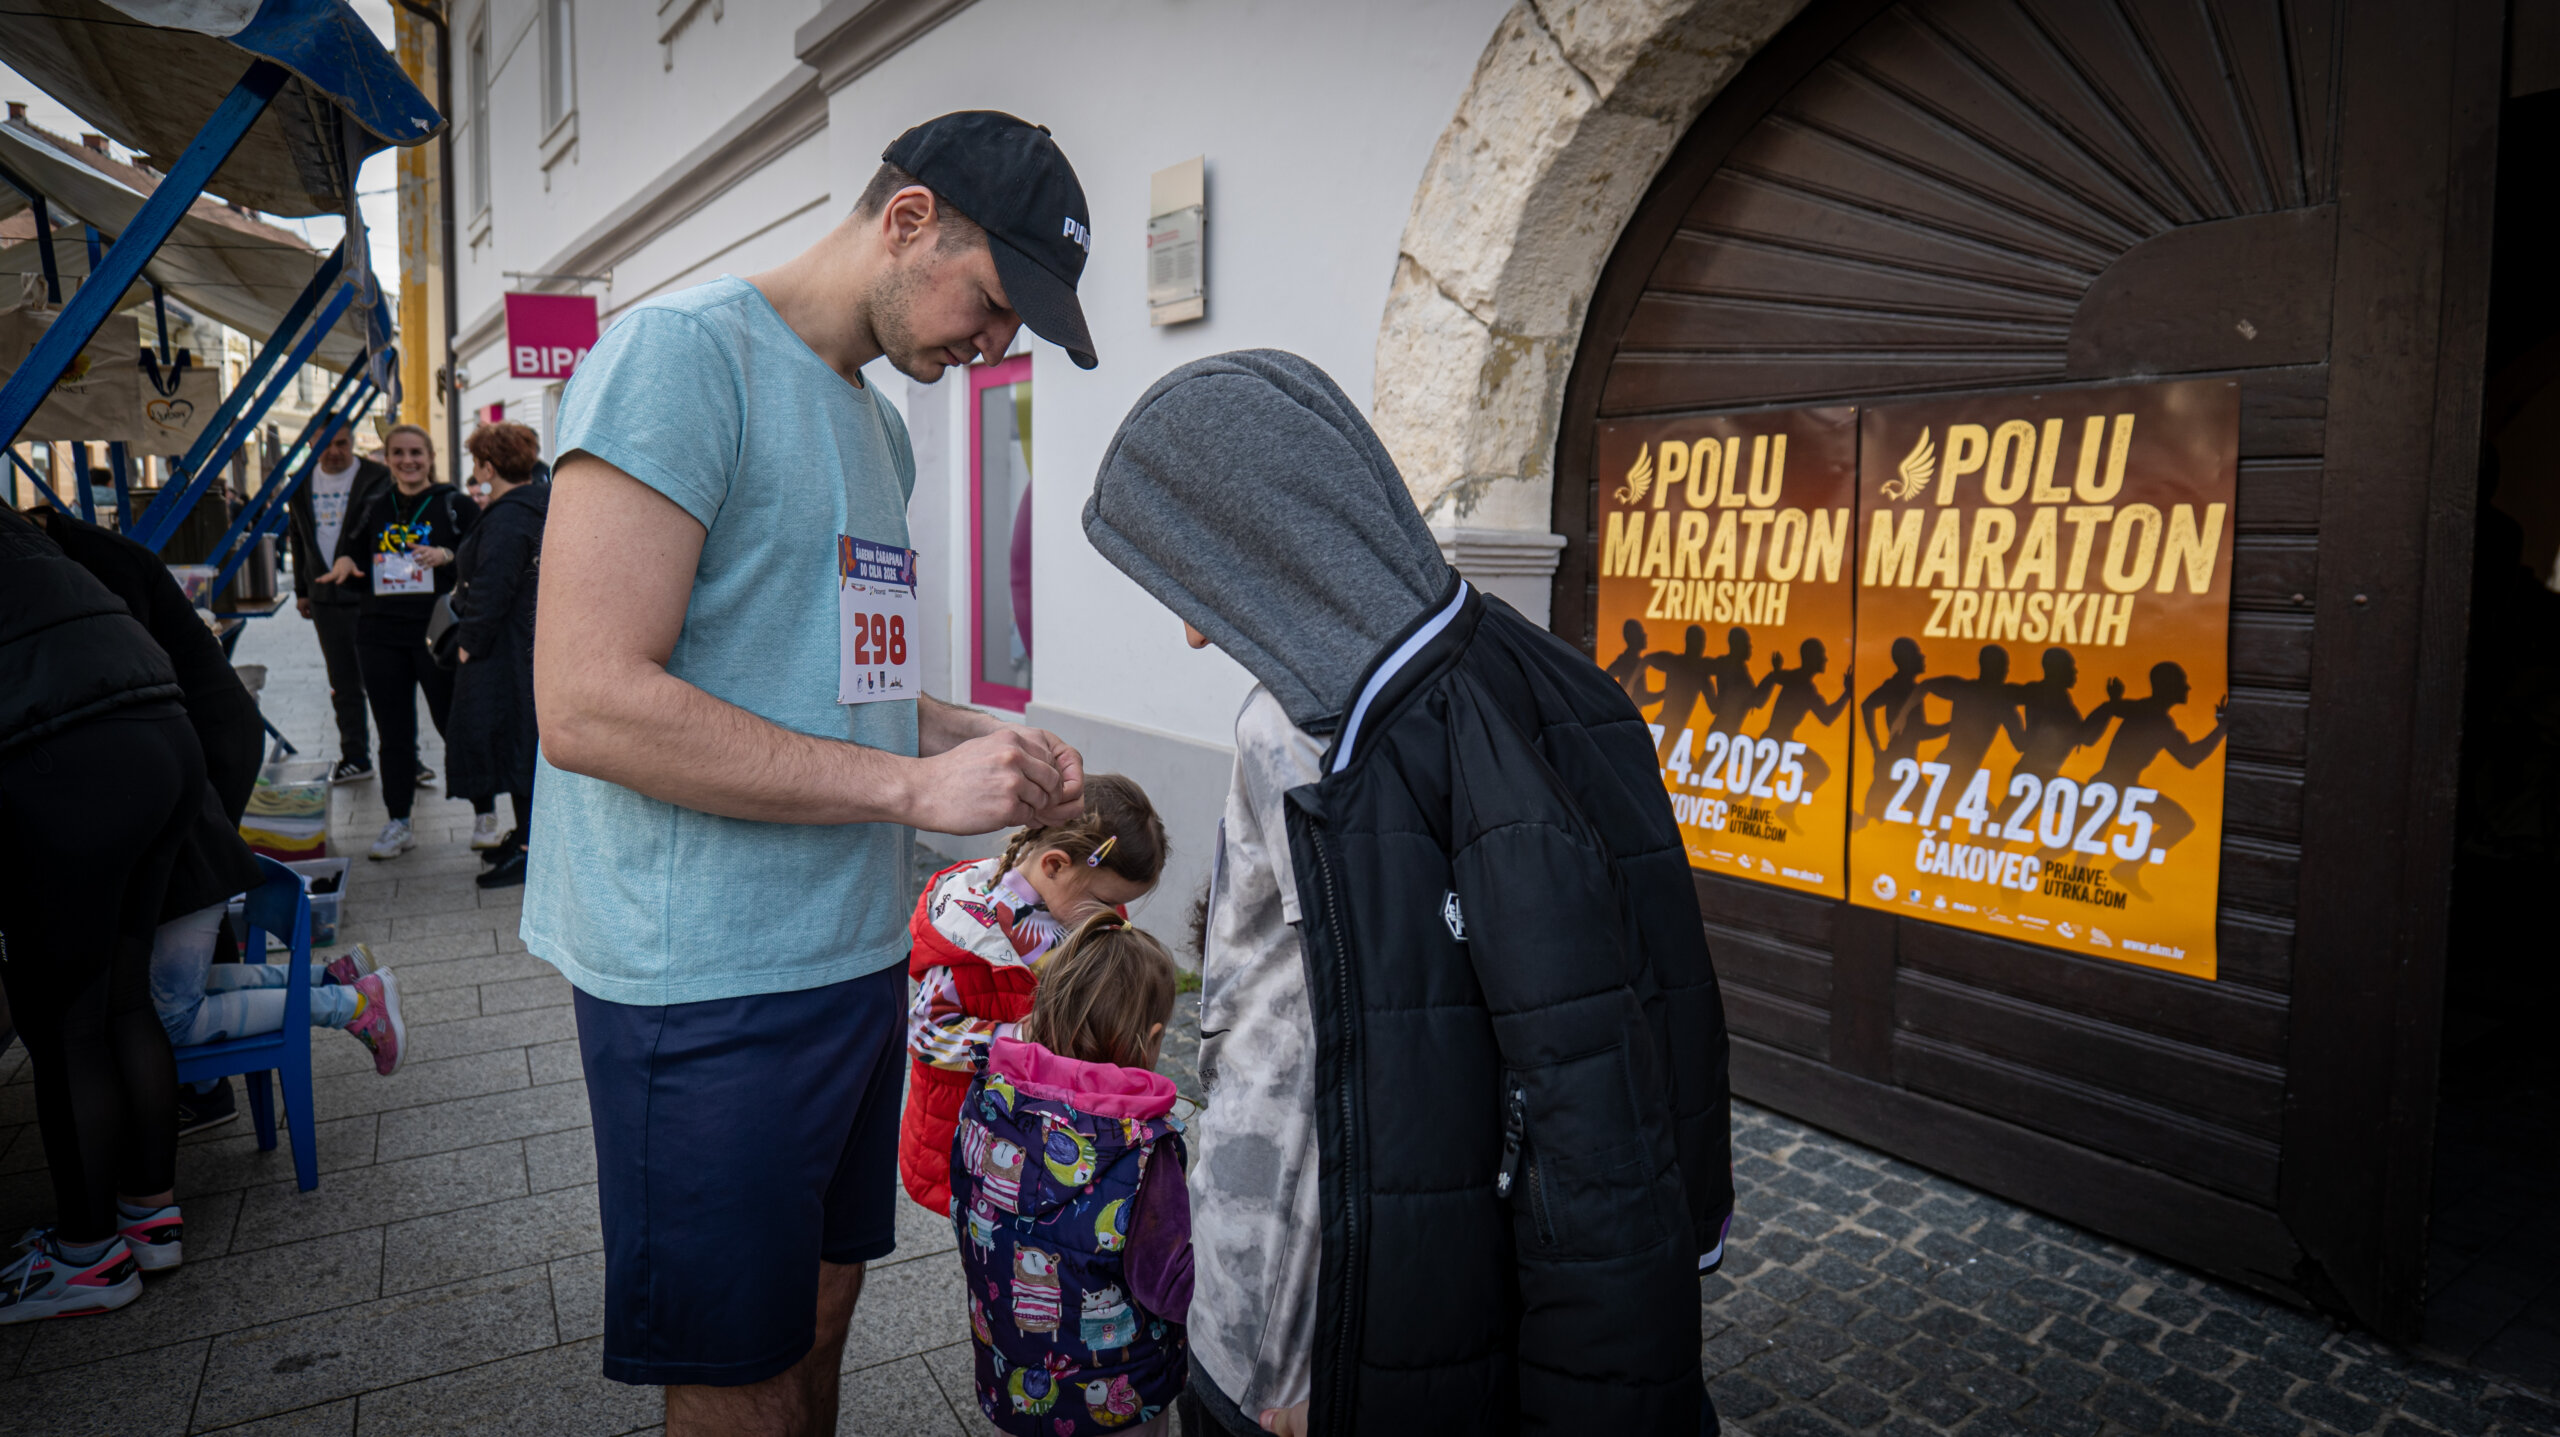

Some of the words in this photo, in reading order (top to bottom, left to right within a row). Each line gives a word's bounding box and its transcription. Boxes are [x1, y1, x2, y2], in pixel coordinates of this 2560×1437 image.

[1652, 434, 1788, 510] POLU
[1935, 413, 2135, 506] POLU
[1602, 507, 1850, 584] MARATON
[1861, 502, 2227, 595] MARATON
[1645, 579, 1790, 627] ZRINSKIH
[1923, 590, 2136, 647] ZRINSKIH
[854, 612, 907, 666] 298
[1729, 820, 1787, 843] UTRKA.COM
[1730, 804, 1775, 825] PRIJAVE:
[1884, 757, 2167, 865] 27.4.2025.
[1915, 830, 2041, 893] ČAKOVEC
[2045, 860, 2108, 888] PRIJAVE:
[2044, 879, 2127, 911] UTRKA.COM
[2121, 937, 2186, 961] www.akm.hr
